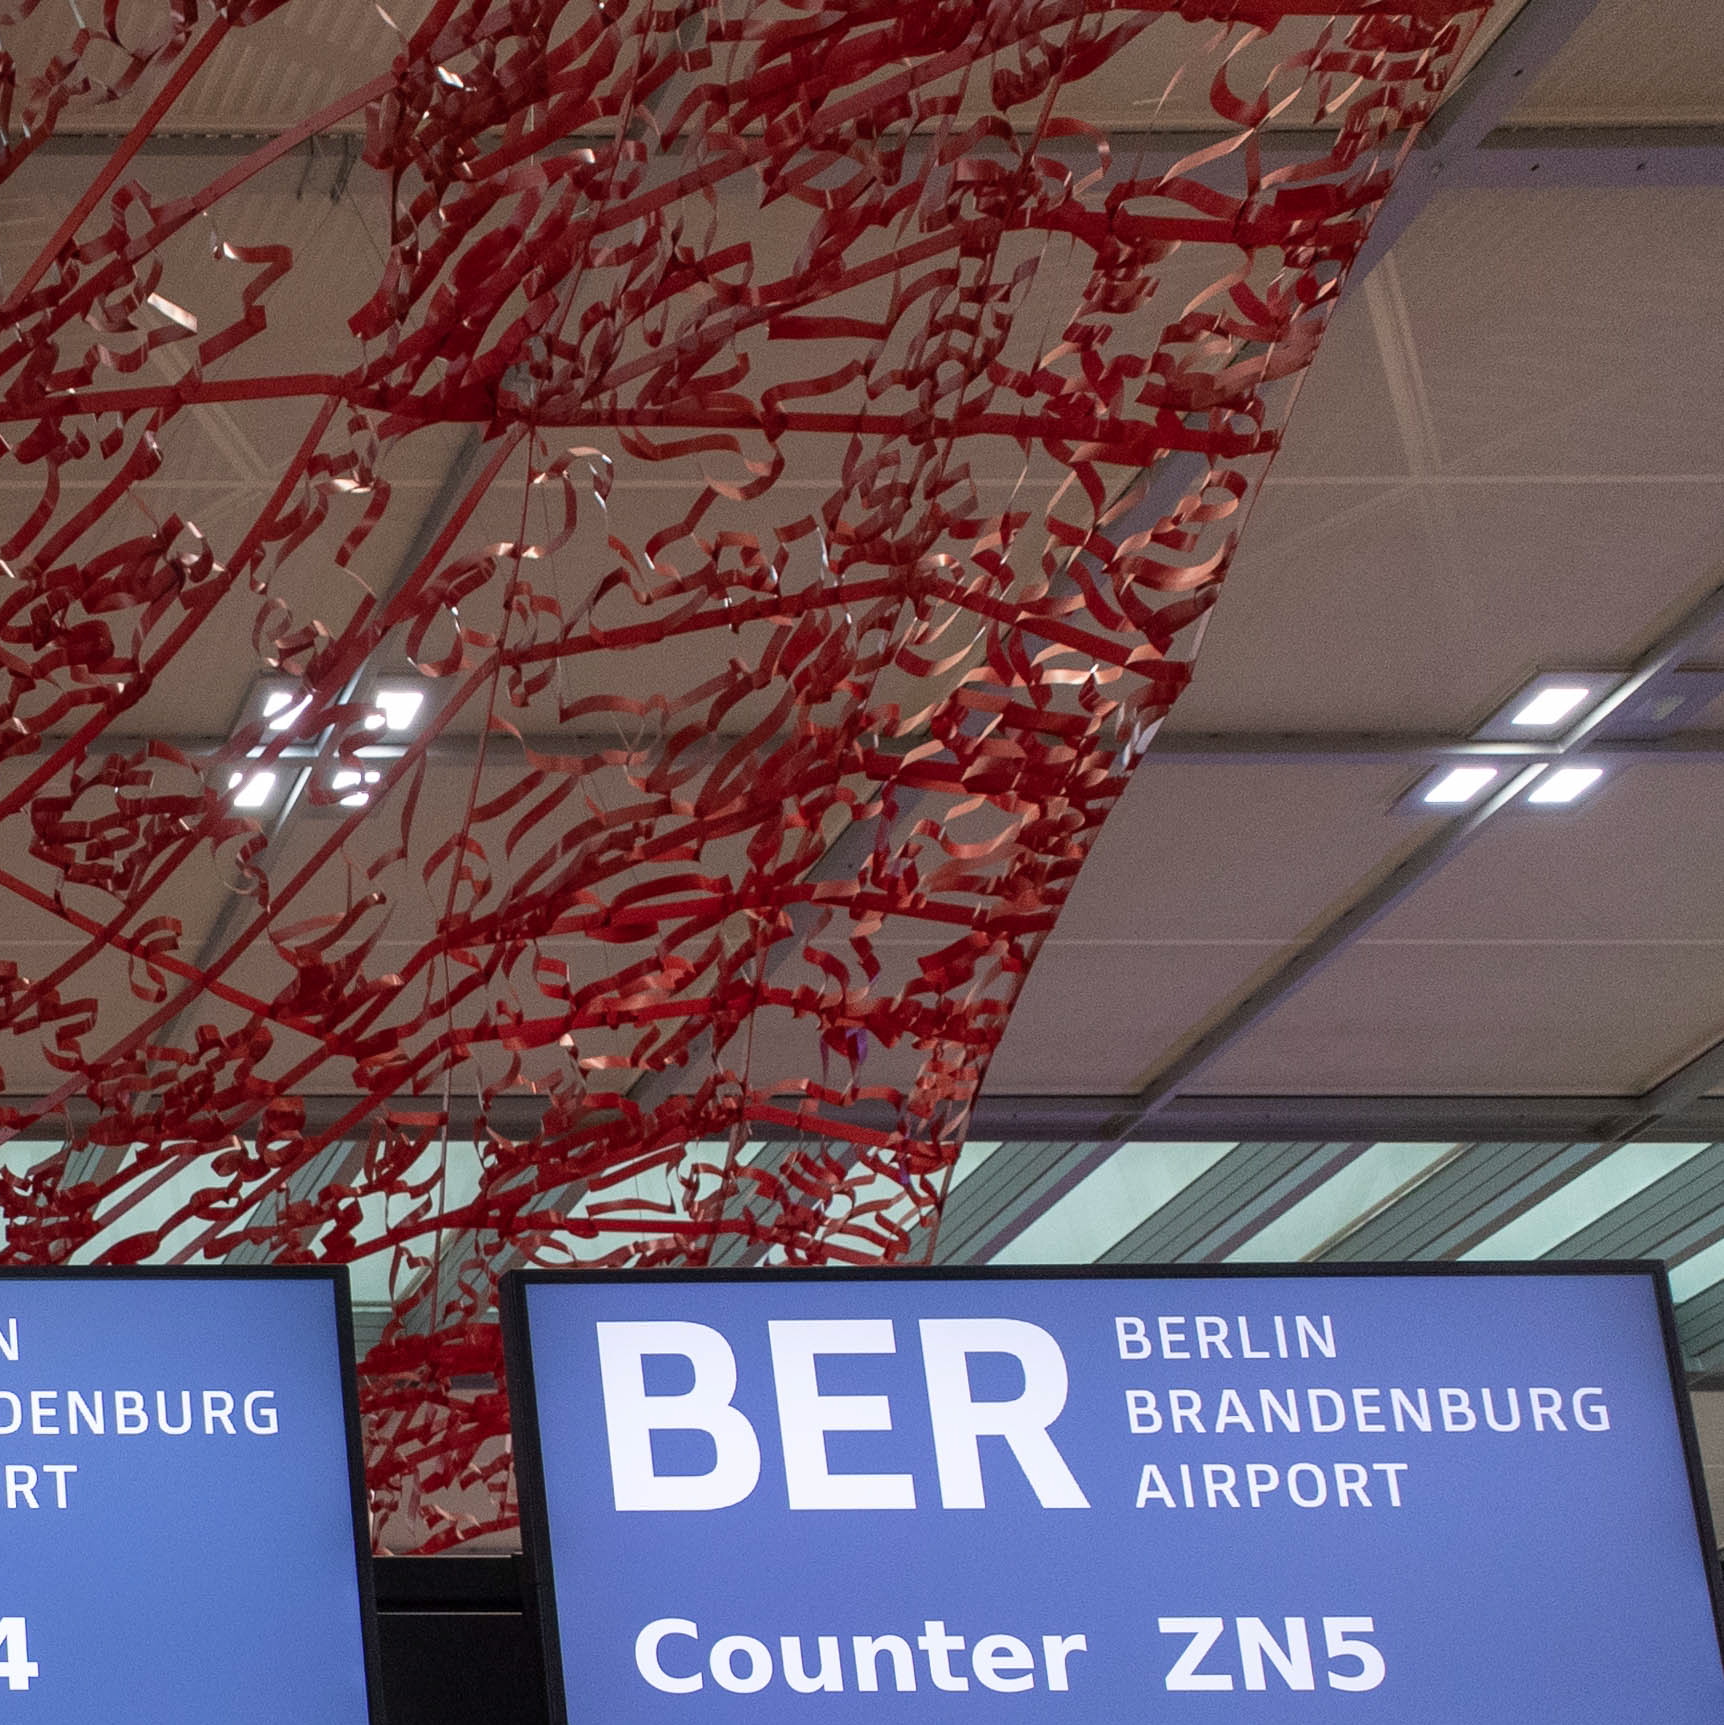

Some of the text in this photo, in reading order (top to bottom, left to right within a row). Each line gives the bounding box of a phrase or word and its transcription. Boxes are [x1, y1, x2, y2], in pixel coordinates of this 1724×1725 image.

[1115, 1315, 1337, 1360] BERLIN
[596, 1318, 1091, 1512] BER
[1125, 1387, 1611, 1434] BRANDENBURG
[1135, 1462, 1409, 1509] AIRPORT
[635, 1616, 1386, 1694] Counter ZN5
